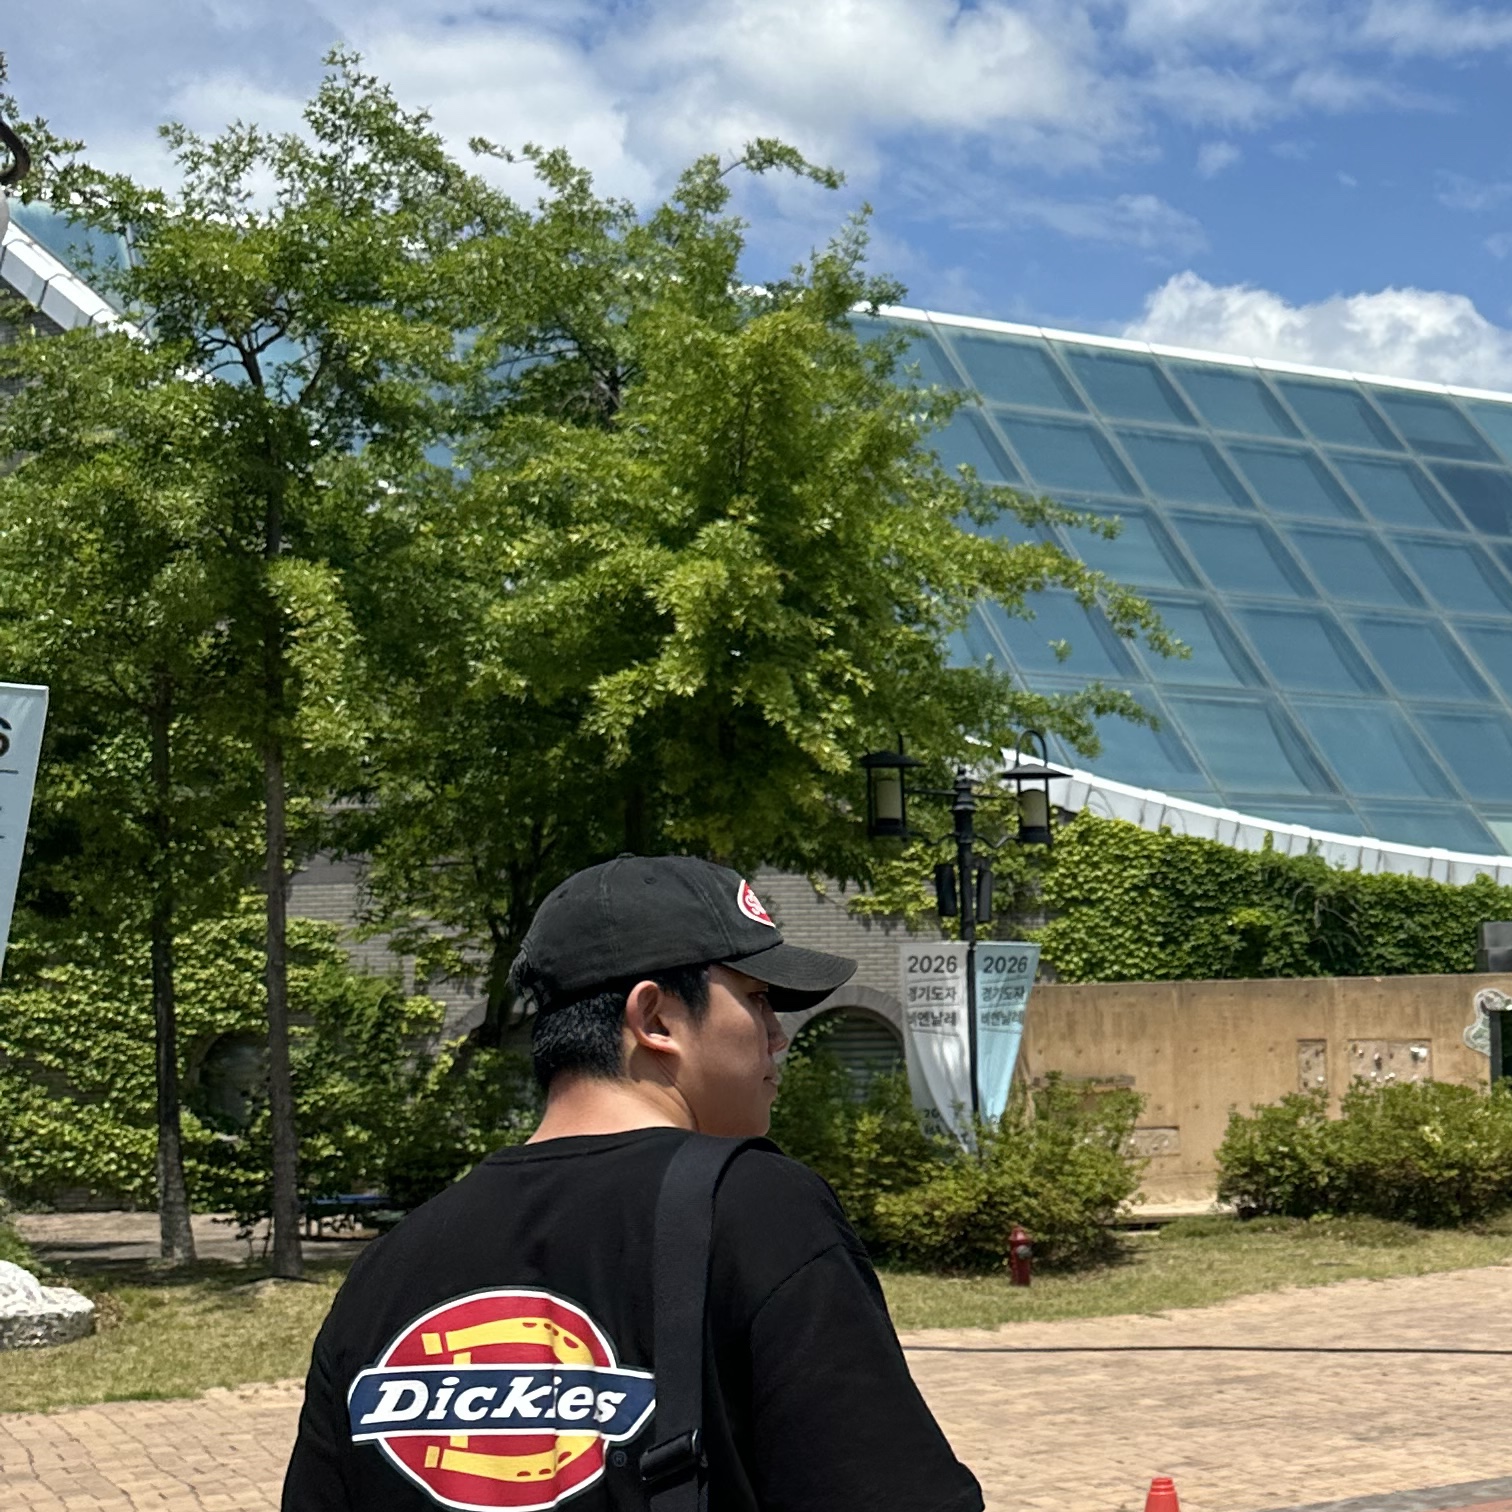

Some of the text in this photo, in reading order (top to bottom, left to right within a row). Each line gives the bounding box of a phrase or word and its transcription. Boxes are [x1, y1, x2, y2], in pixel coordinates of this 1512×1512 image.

[908, 956, 957, 973] 2026
[983, 956, 1028, 974] 2026
[360, 1375, 627, 1425] Dickies
